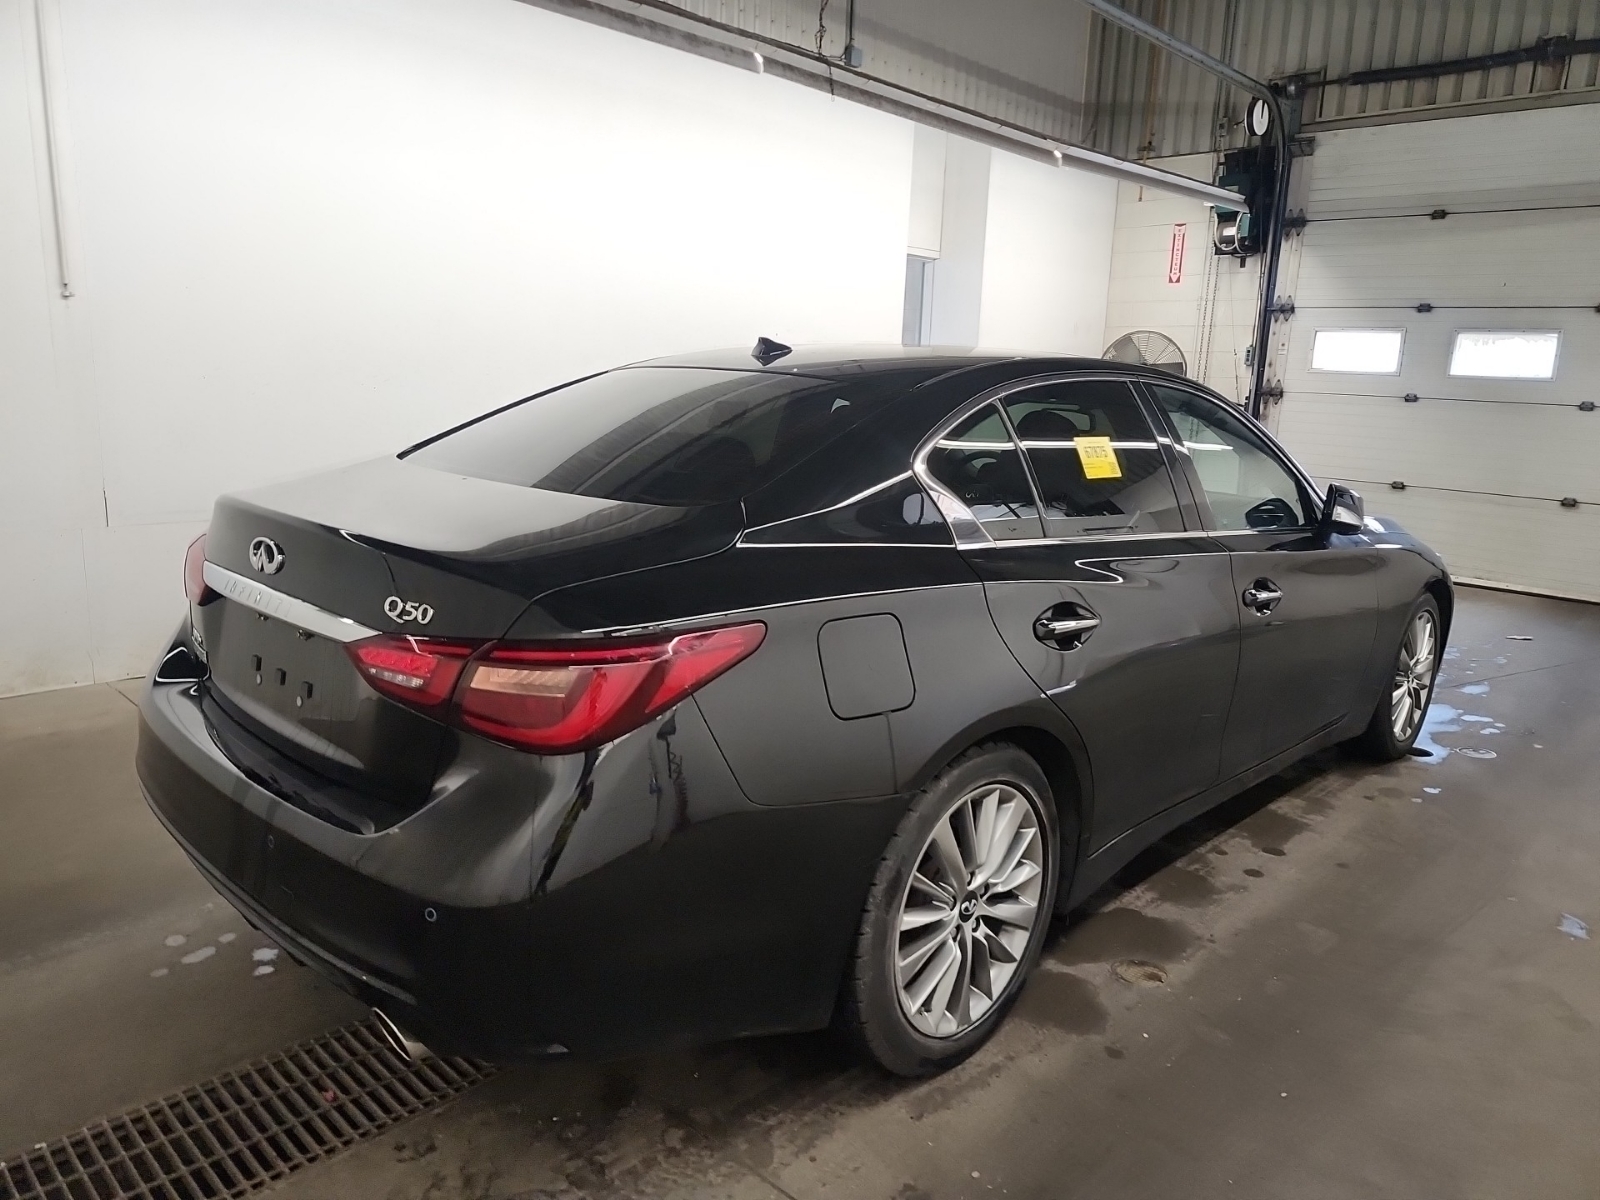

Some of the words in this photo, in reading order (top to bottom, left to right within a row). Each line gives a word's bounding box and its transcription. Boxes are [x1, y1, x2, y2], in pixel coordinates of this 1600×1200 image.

[1173, 228, 1182, 276] EXTINCTEUR
[223, 578, 293, 618] INFINITI
[383, 595, 435, 625] Q50
